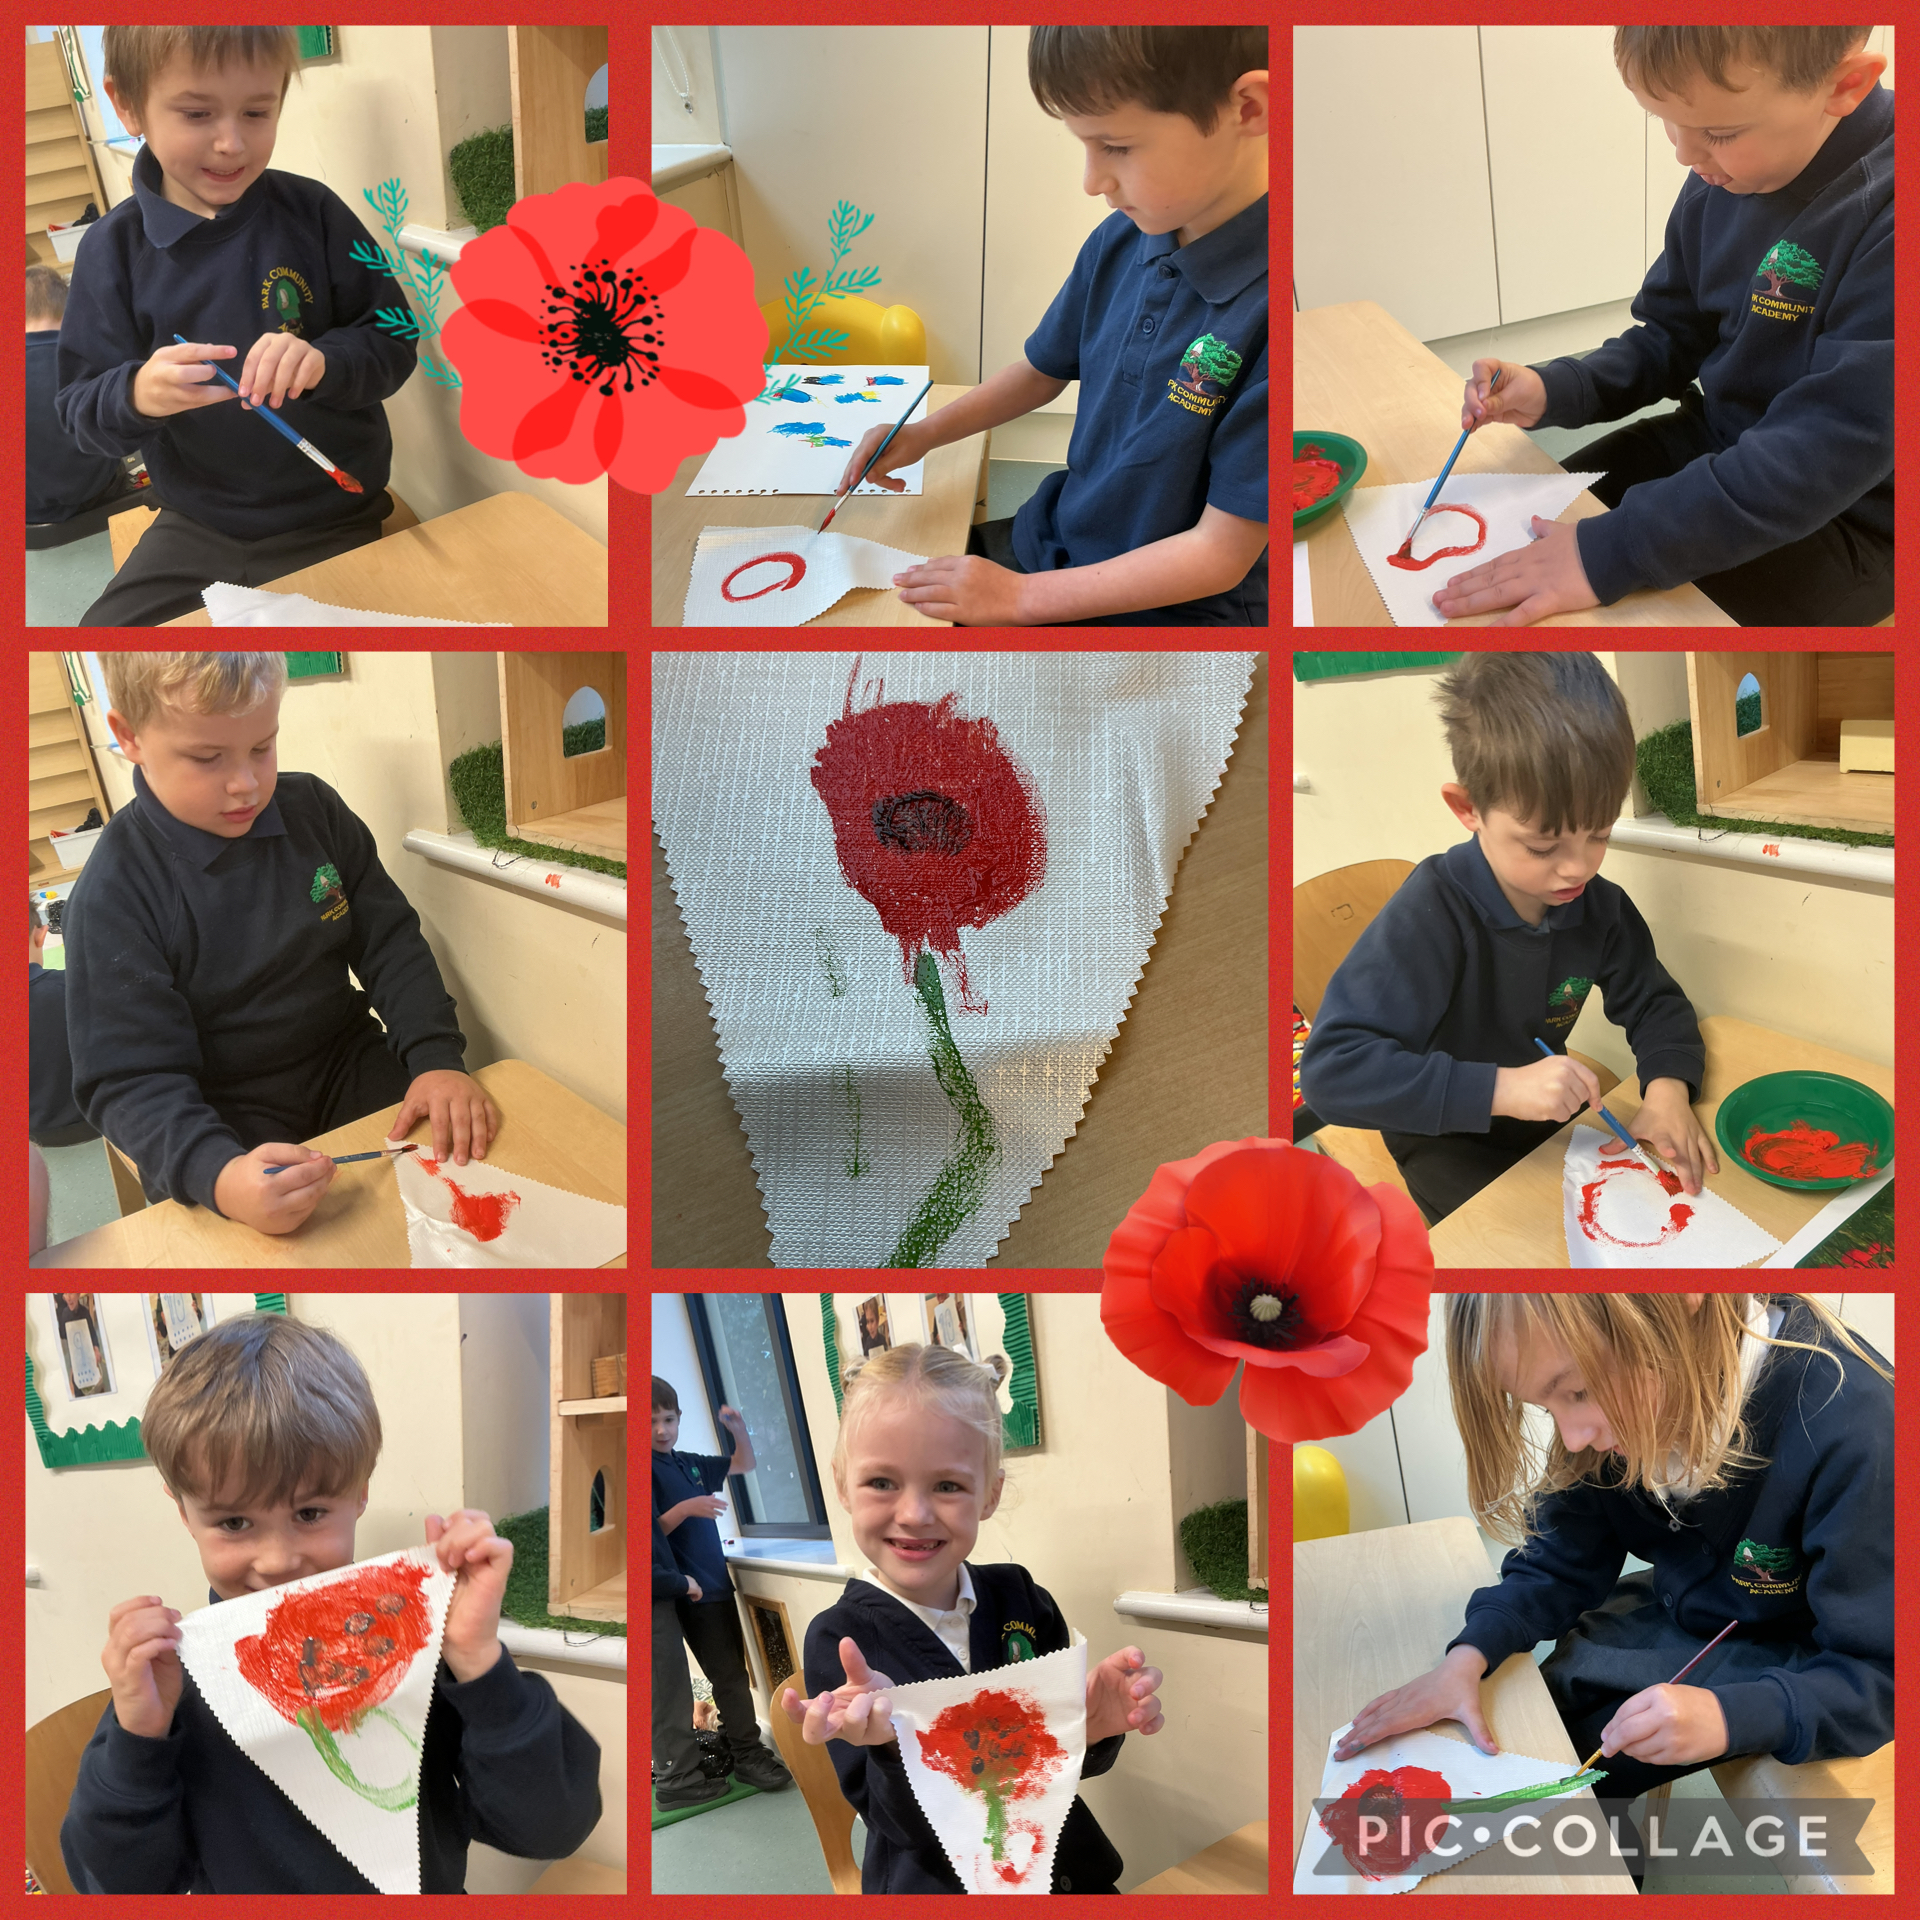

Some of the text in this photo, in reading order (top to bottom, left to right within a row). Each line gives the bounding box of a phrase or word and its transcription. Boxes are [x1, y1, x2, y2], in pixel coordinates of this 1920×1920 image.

[261, 266, 314, 310] PARK COMMUNITY
[1750, 304, 1800, 322] ACADEMY
[1758, 296, 1816, 315] COMMUNIT
[1167, 392, 1215, 416] ACADEMY
[1749, 1584, 1799, 1595] ACADEMY
[1003, 1620, 1037, 1641] COMMU
